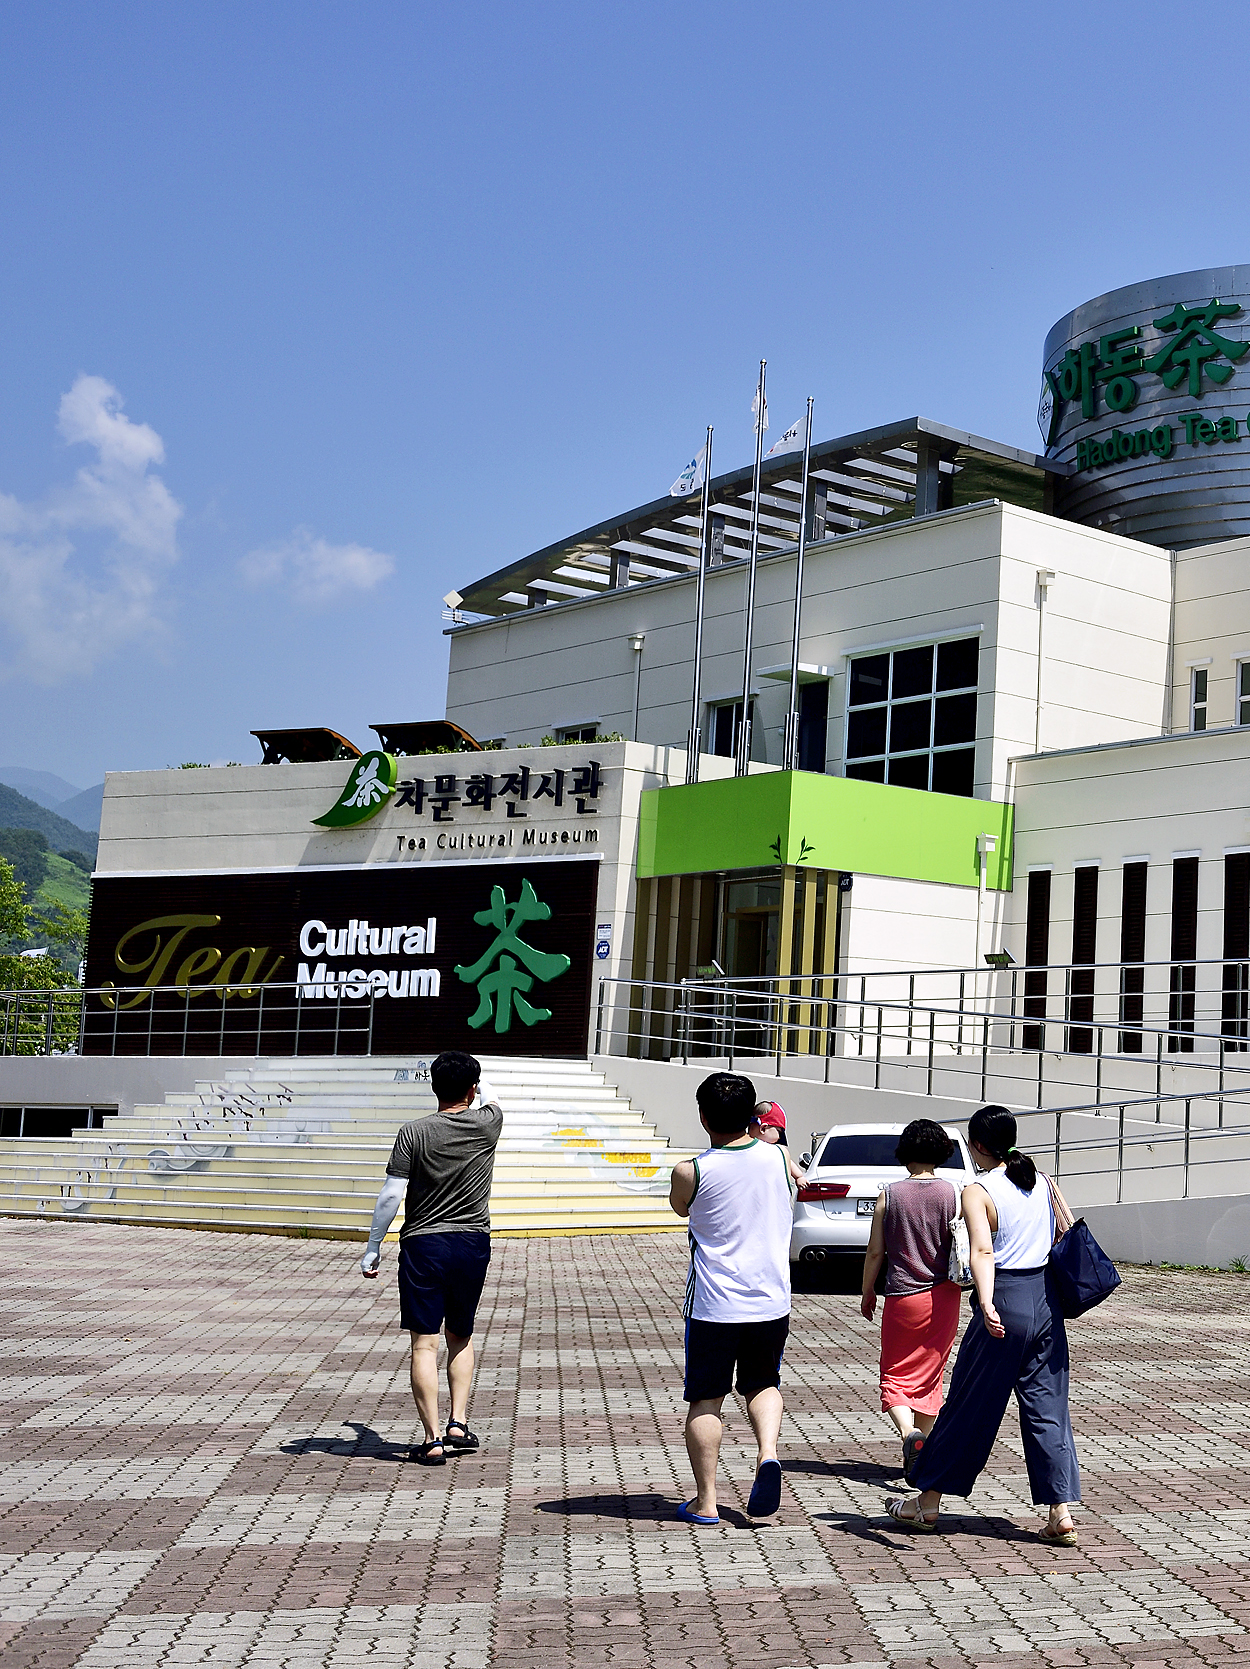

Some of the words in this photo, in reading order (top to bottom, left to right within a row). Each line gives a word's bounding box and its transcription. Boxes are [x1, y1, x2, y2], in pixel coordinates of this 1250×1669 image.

[1076, 423, 1173, 471] Hadong
[1178, 412, 1239, 446] Tea
[394, 760, 604, 823] 차문화전시관
[396, 834, 427, 852] Tea
[436, 829, 515, 851] Cultural
[522, 828, 600, 846] Museum
[99, 913, 286, 1011] Tea
[299, 917, 438, 957] Cultural
[453, 877, 572, 1034] 茶
[295, 962, 442, 999] Museum
